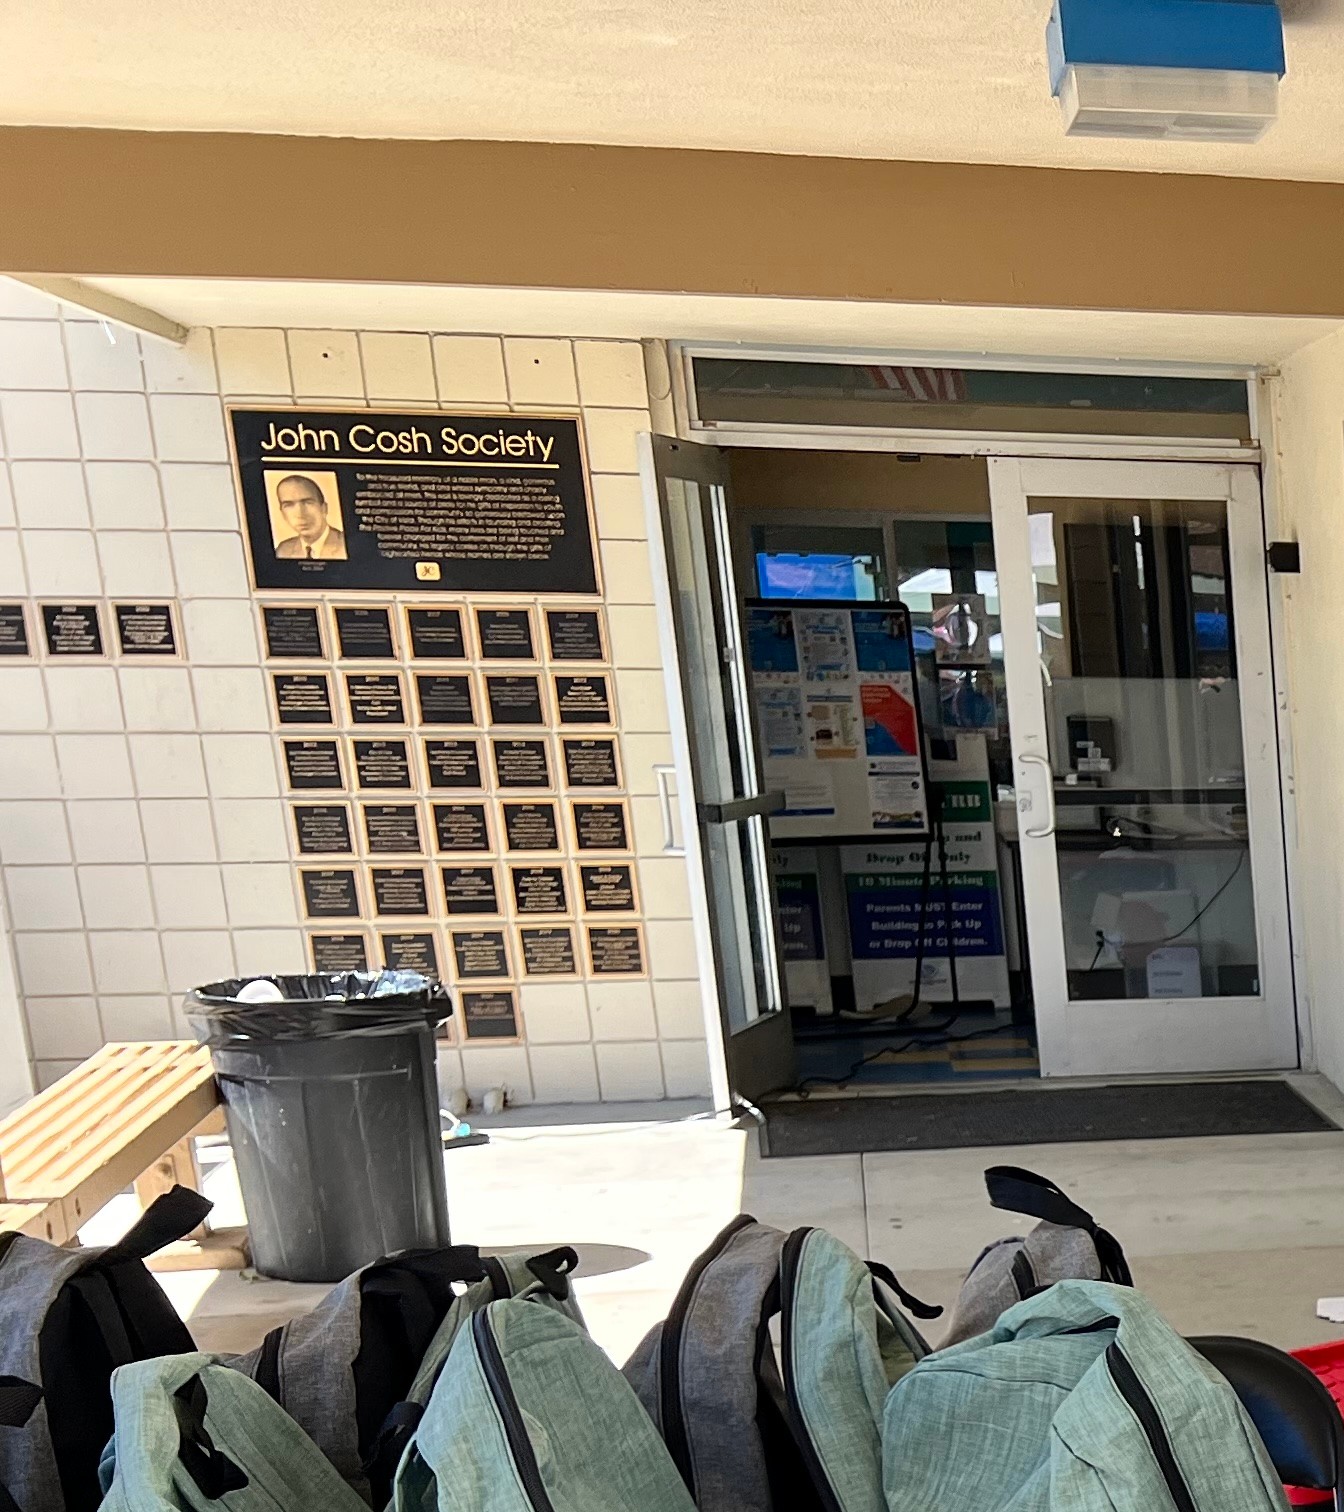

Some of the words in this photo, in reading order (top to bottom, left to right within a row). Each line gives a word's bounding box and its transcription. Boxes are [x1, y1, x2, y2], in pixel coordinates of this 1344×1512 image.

[260, 422, 340, 452] John
[349, 424, 432, 453] Cosh
[442, 427, 554, 462] Society
[955, 831, 981, 842] and
[867, 852, 904, 865] Drop
[866, 903, 911, 913] Parents
[951, 901, 983, 912] Enter
[871, 920, 920, 932] Building
[965, 918, 982, 931] Up
[884, 938, 912, 950] Drop
